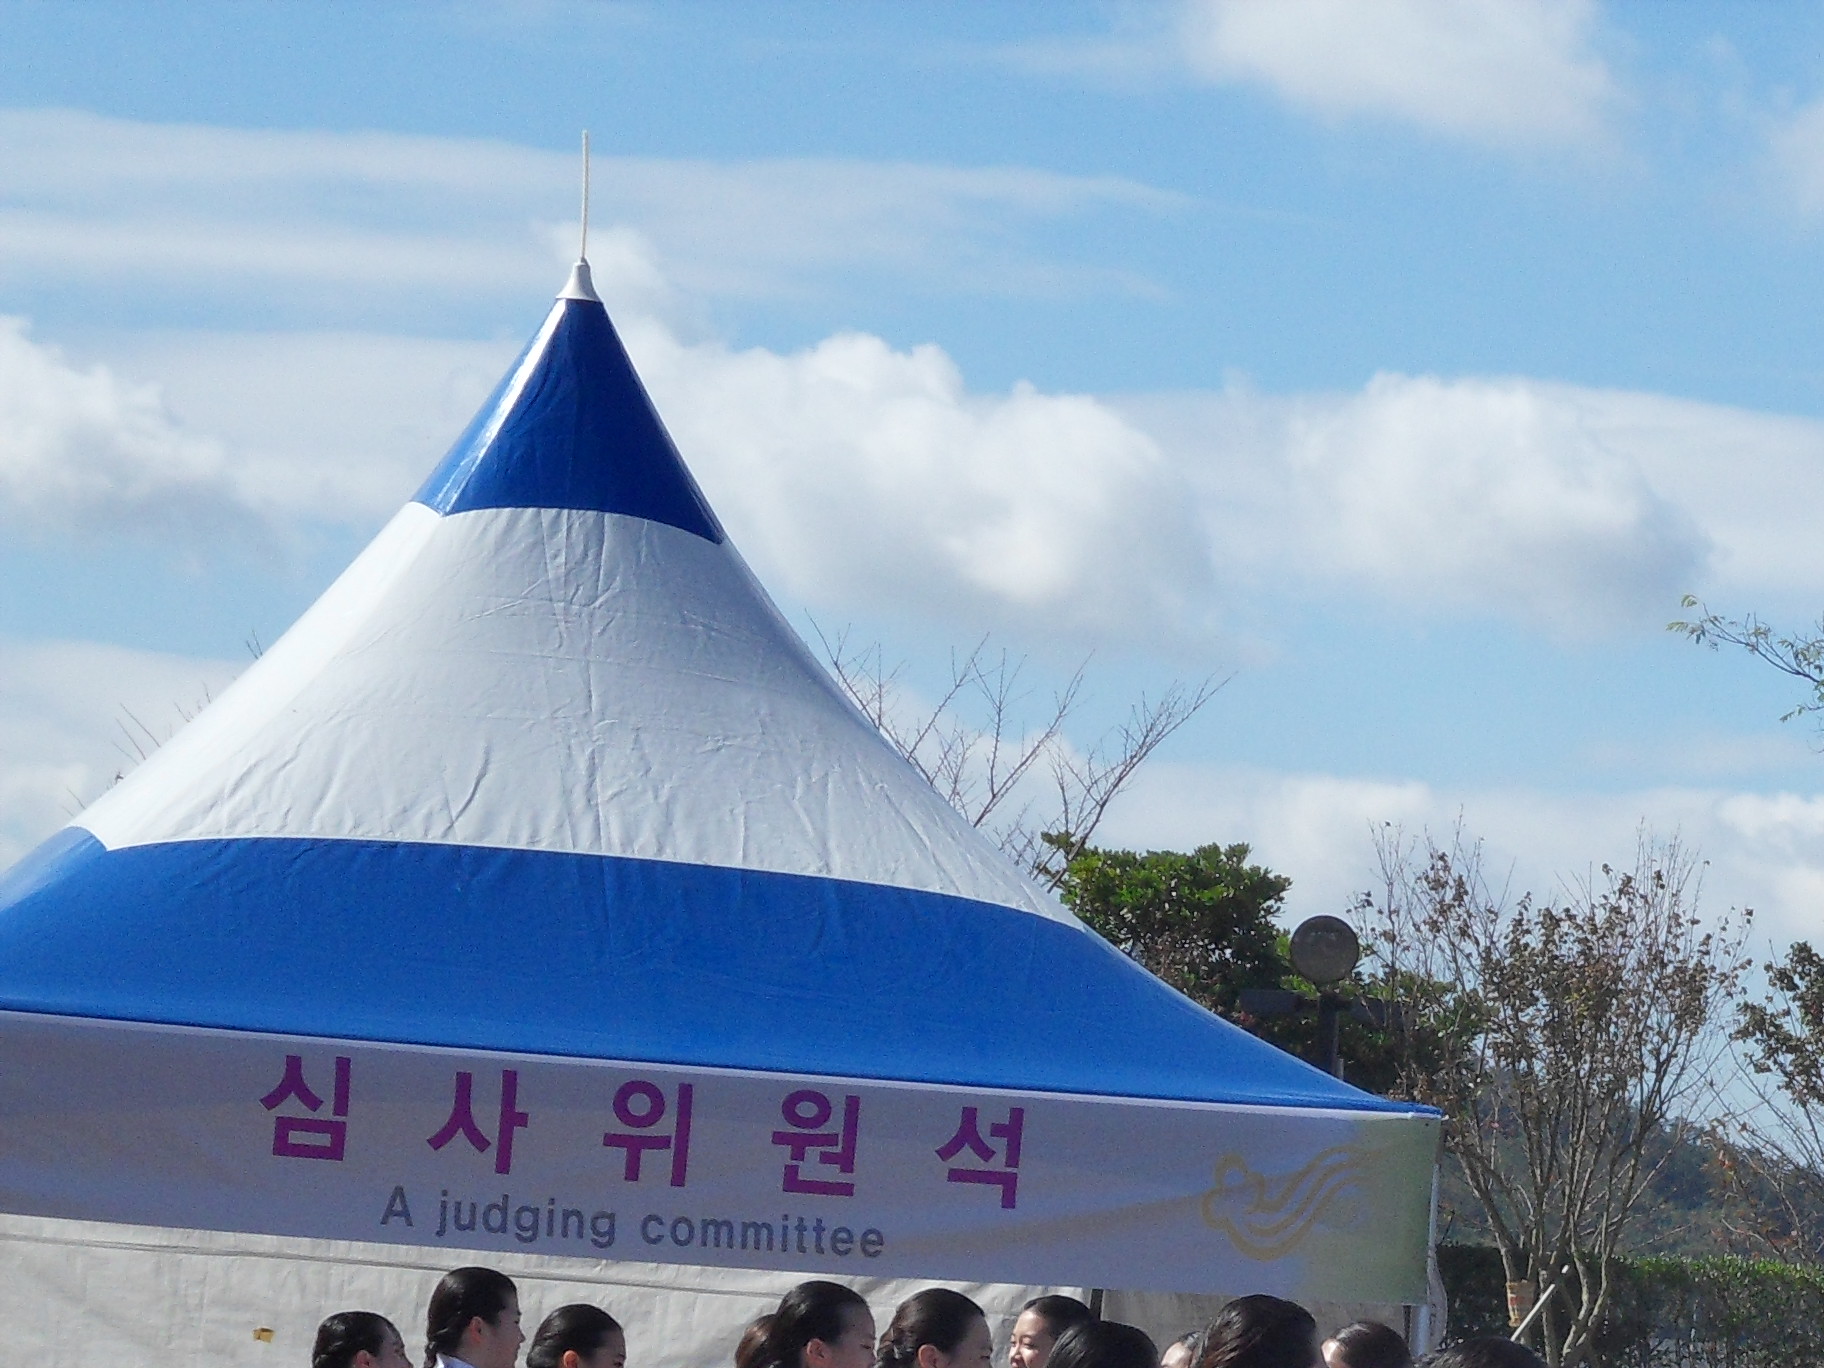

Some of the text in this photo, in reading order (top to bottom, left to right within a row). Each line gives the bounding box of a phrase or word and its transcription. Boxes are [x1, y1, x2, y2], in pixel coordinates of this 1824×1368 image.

[380, 1186, 884, 1258] A judging committee
